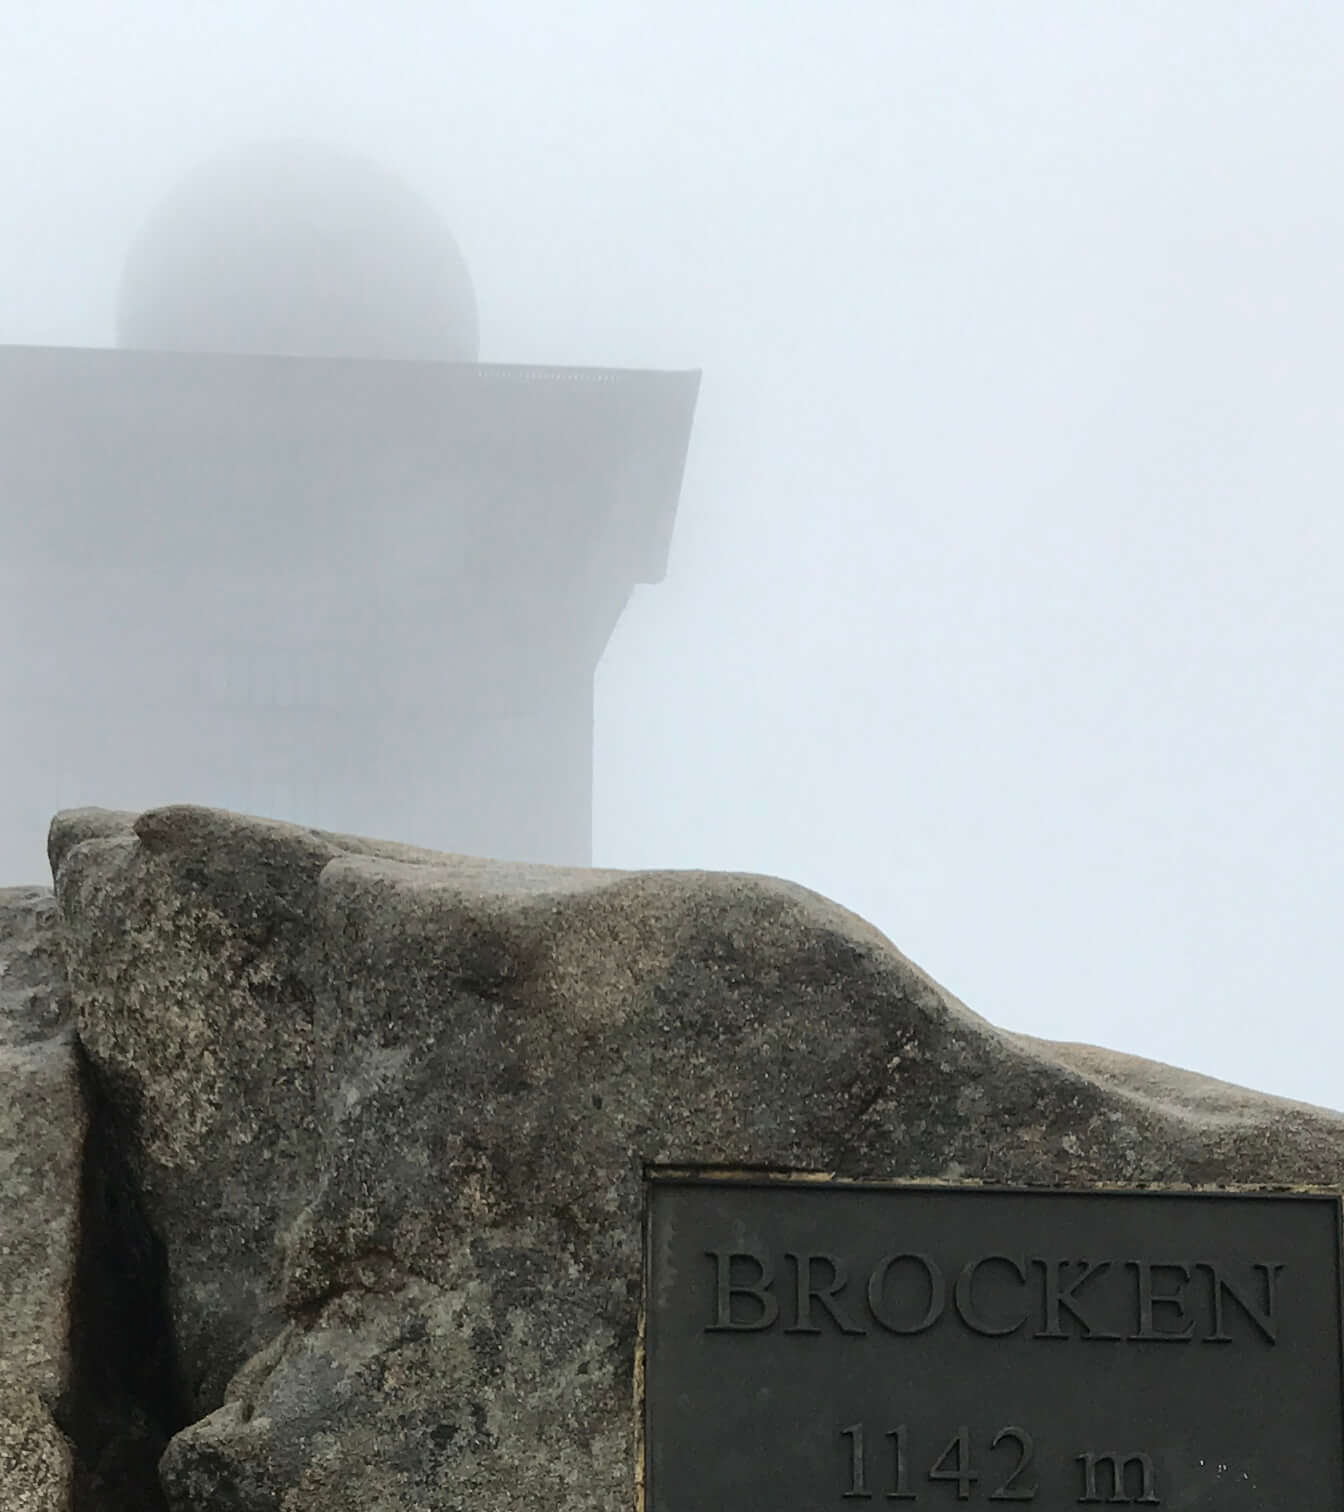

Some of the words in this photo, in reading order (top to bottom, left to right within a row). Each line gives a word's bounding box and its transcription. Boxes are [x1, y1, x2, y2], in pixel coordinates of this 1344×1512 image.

[705, 1250, 1285, 1345] BROCKEN
[839, 1422, 1039, 1501] 1142
[1076, 1450, 1160, 1504] m
